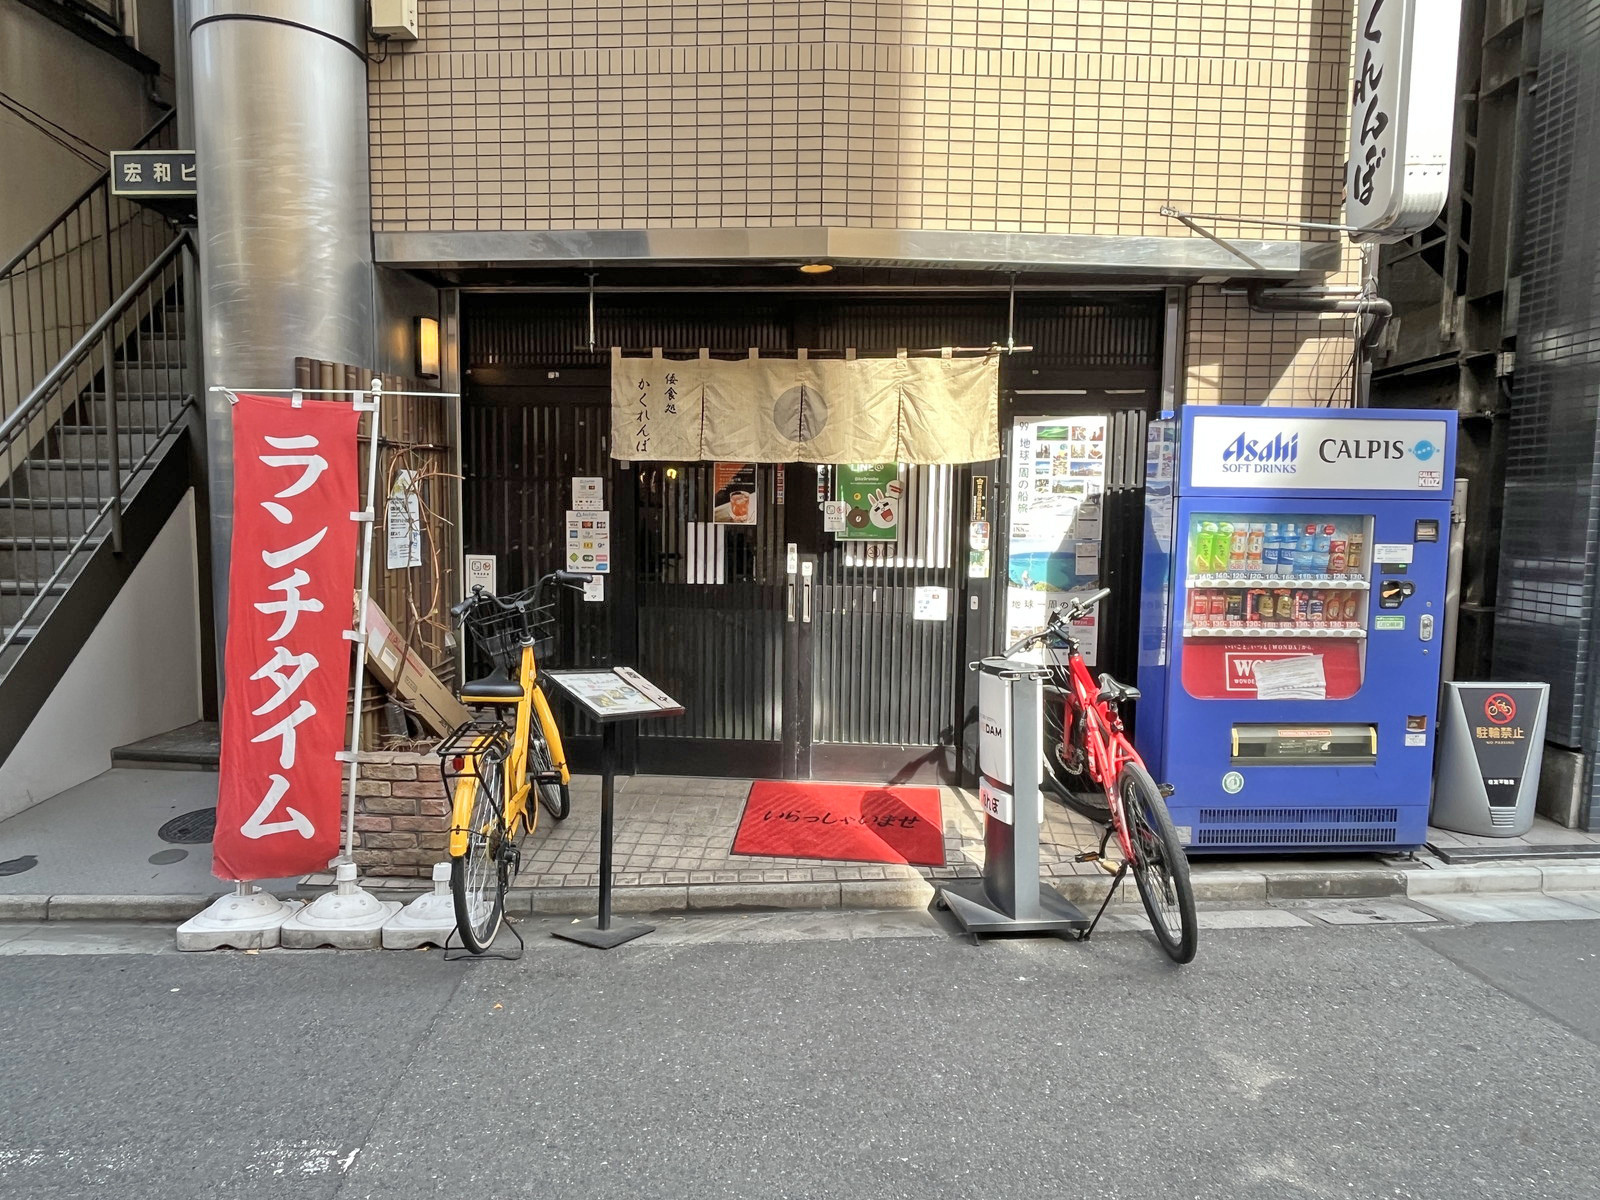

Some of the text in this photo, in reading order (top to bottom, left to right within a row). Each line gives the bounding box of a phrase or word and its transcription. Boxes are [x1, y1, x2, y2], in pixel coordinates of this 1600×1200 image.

[636, 378, 651, 452] かくれんぼ
[1222, 431, 1299, 462] Asahi
[1318, 438, 1404, 463] CALPIS
[1222, 463, 1297, 474] SOFT DRINKS
[240, 434, 329, 840] ランチタイム
[985, 723, 1002, 738] DAM
[1476, 726, 1525, 739] 駐輪禁止
[763, 810, 920, 829] いらっしゃいませ
